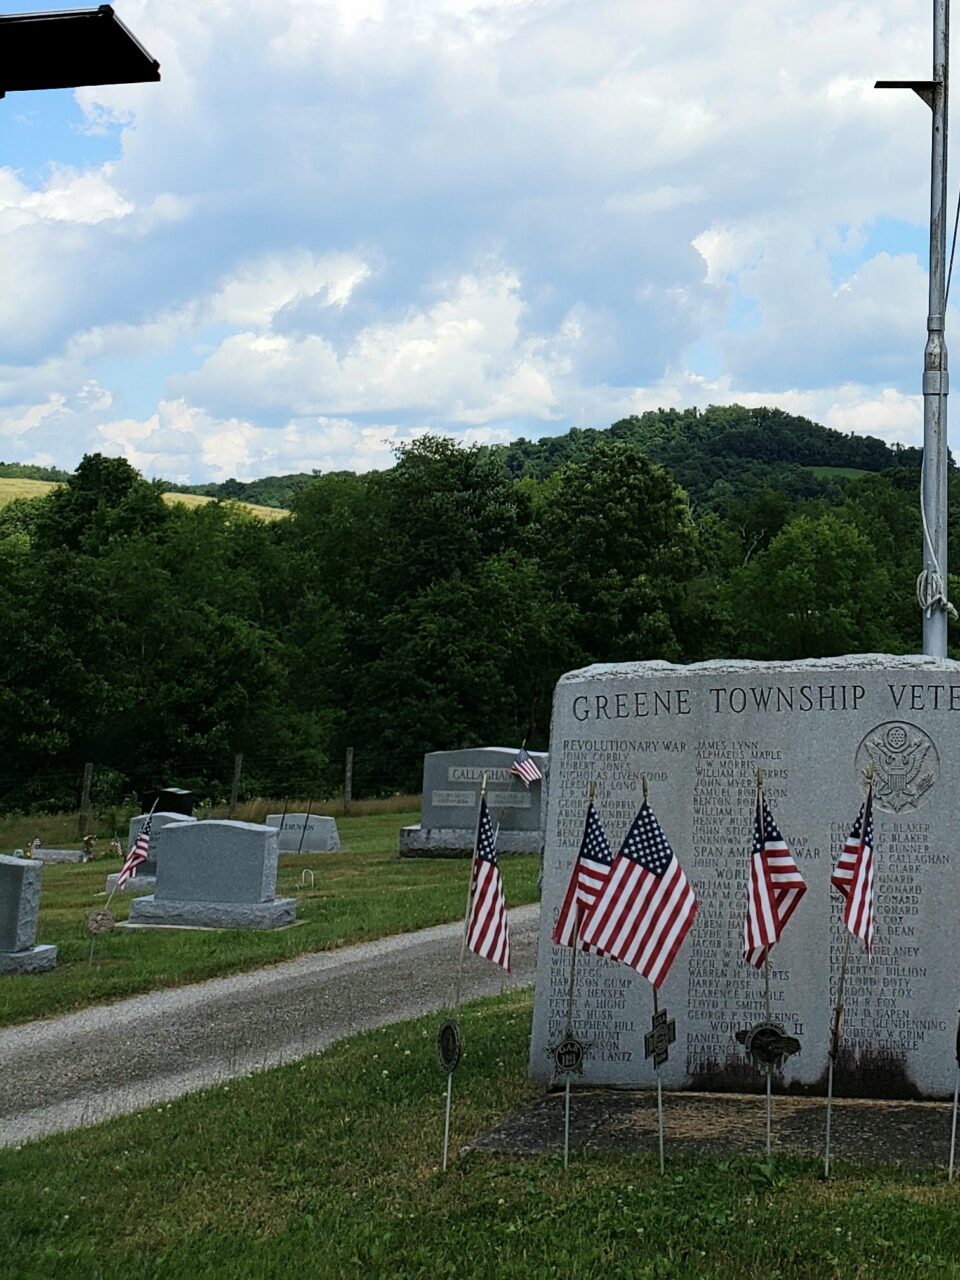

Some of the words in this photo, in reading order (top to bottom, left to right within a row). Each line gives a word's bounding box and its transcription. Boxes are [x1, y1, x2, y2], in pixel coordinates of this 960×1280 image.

[573, 690, 690, 721] GREENE
[710, 685, 866, 714] TOWNSHIP
[563, 740, 659, 752] REVOLUTIONARY
[662, 741, 687, 753] WAR
[695, 740, 727, 751] JAMES
[733, 740, 759, 751] LYNN
[561, 752, 587, 761] JOHN
[695, 750, 745, 760] ALPHAEUS
[751, 750, 782, 760] MAPLE
[600, 761, 631, 771] JONES
[720, 760, 756, 770] MORRIS
[696, 769, 735, 780] WILLIAM
[611, 781, 636, 791] LONG
[695, 778, 721, 788] JOHN
[694, 787, 731, 797] SAMUEL
[693, 797, 731, 807] BENTON
[694, 807, 732, 817] WILLIAM
[692, 816, 723, 826] HENRY
[692, 825, 720, 836] JOHN
[893, 822, 930, 832] BLAKER
[890, 832, 928, 843] BLAKER
[795, 847, 821, 859] WAR
[888, 843, 929, 854] BUNNER
[691, 858, 719, 869] JOHN
[888, 853, 950, 865] CALLAGHAN
[888, 863, 921, 873] CLARK
[692, 879, 731, 890] WILLIAM
[879, 884, 922, 895] CONARD
[877, 894, 919, 905] CONARD
[876, 904, 919, 915] CONARD
[883, 914, 904, 925] COX
[690, 928, 722, 939] CLYDE
[887, 924, 915, 936] DEAN
[689, 949, 717, 959] JOHN
[873, 946, 920, 957] DELANEY
[688, 968, 728, 979] WARREN
[688, 979, 720, 989] HARRY
[882, 976, 911, 988] DOTY
[687, 988, 740, 1000] CLARENCE
[892, 988, 913, 999] FOX
[687, 998, 719, 1010] FLOYD
[735, 1000, 766, 1011] SMITH
[877, 998, 897, 1010] FOX
[587, 1009, 614, 1020] HUSK
[687, 1009, 725, 1020] GEORGE
[876, 1009, 910, 1020] GAPEN
[615, 1021, 636, 1032] HILL
[794, 1023, 804, 1036] II
[872, 1019, 947, 1032] GLENDENNING
[594, 1031, 621, 1041] HUNT
[687, 1032, 721, 1044] DANIEL
[899, 1032, 925, 1043] GRIM
